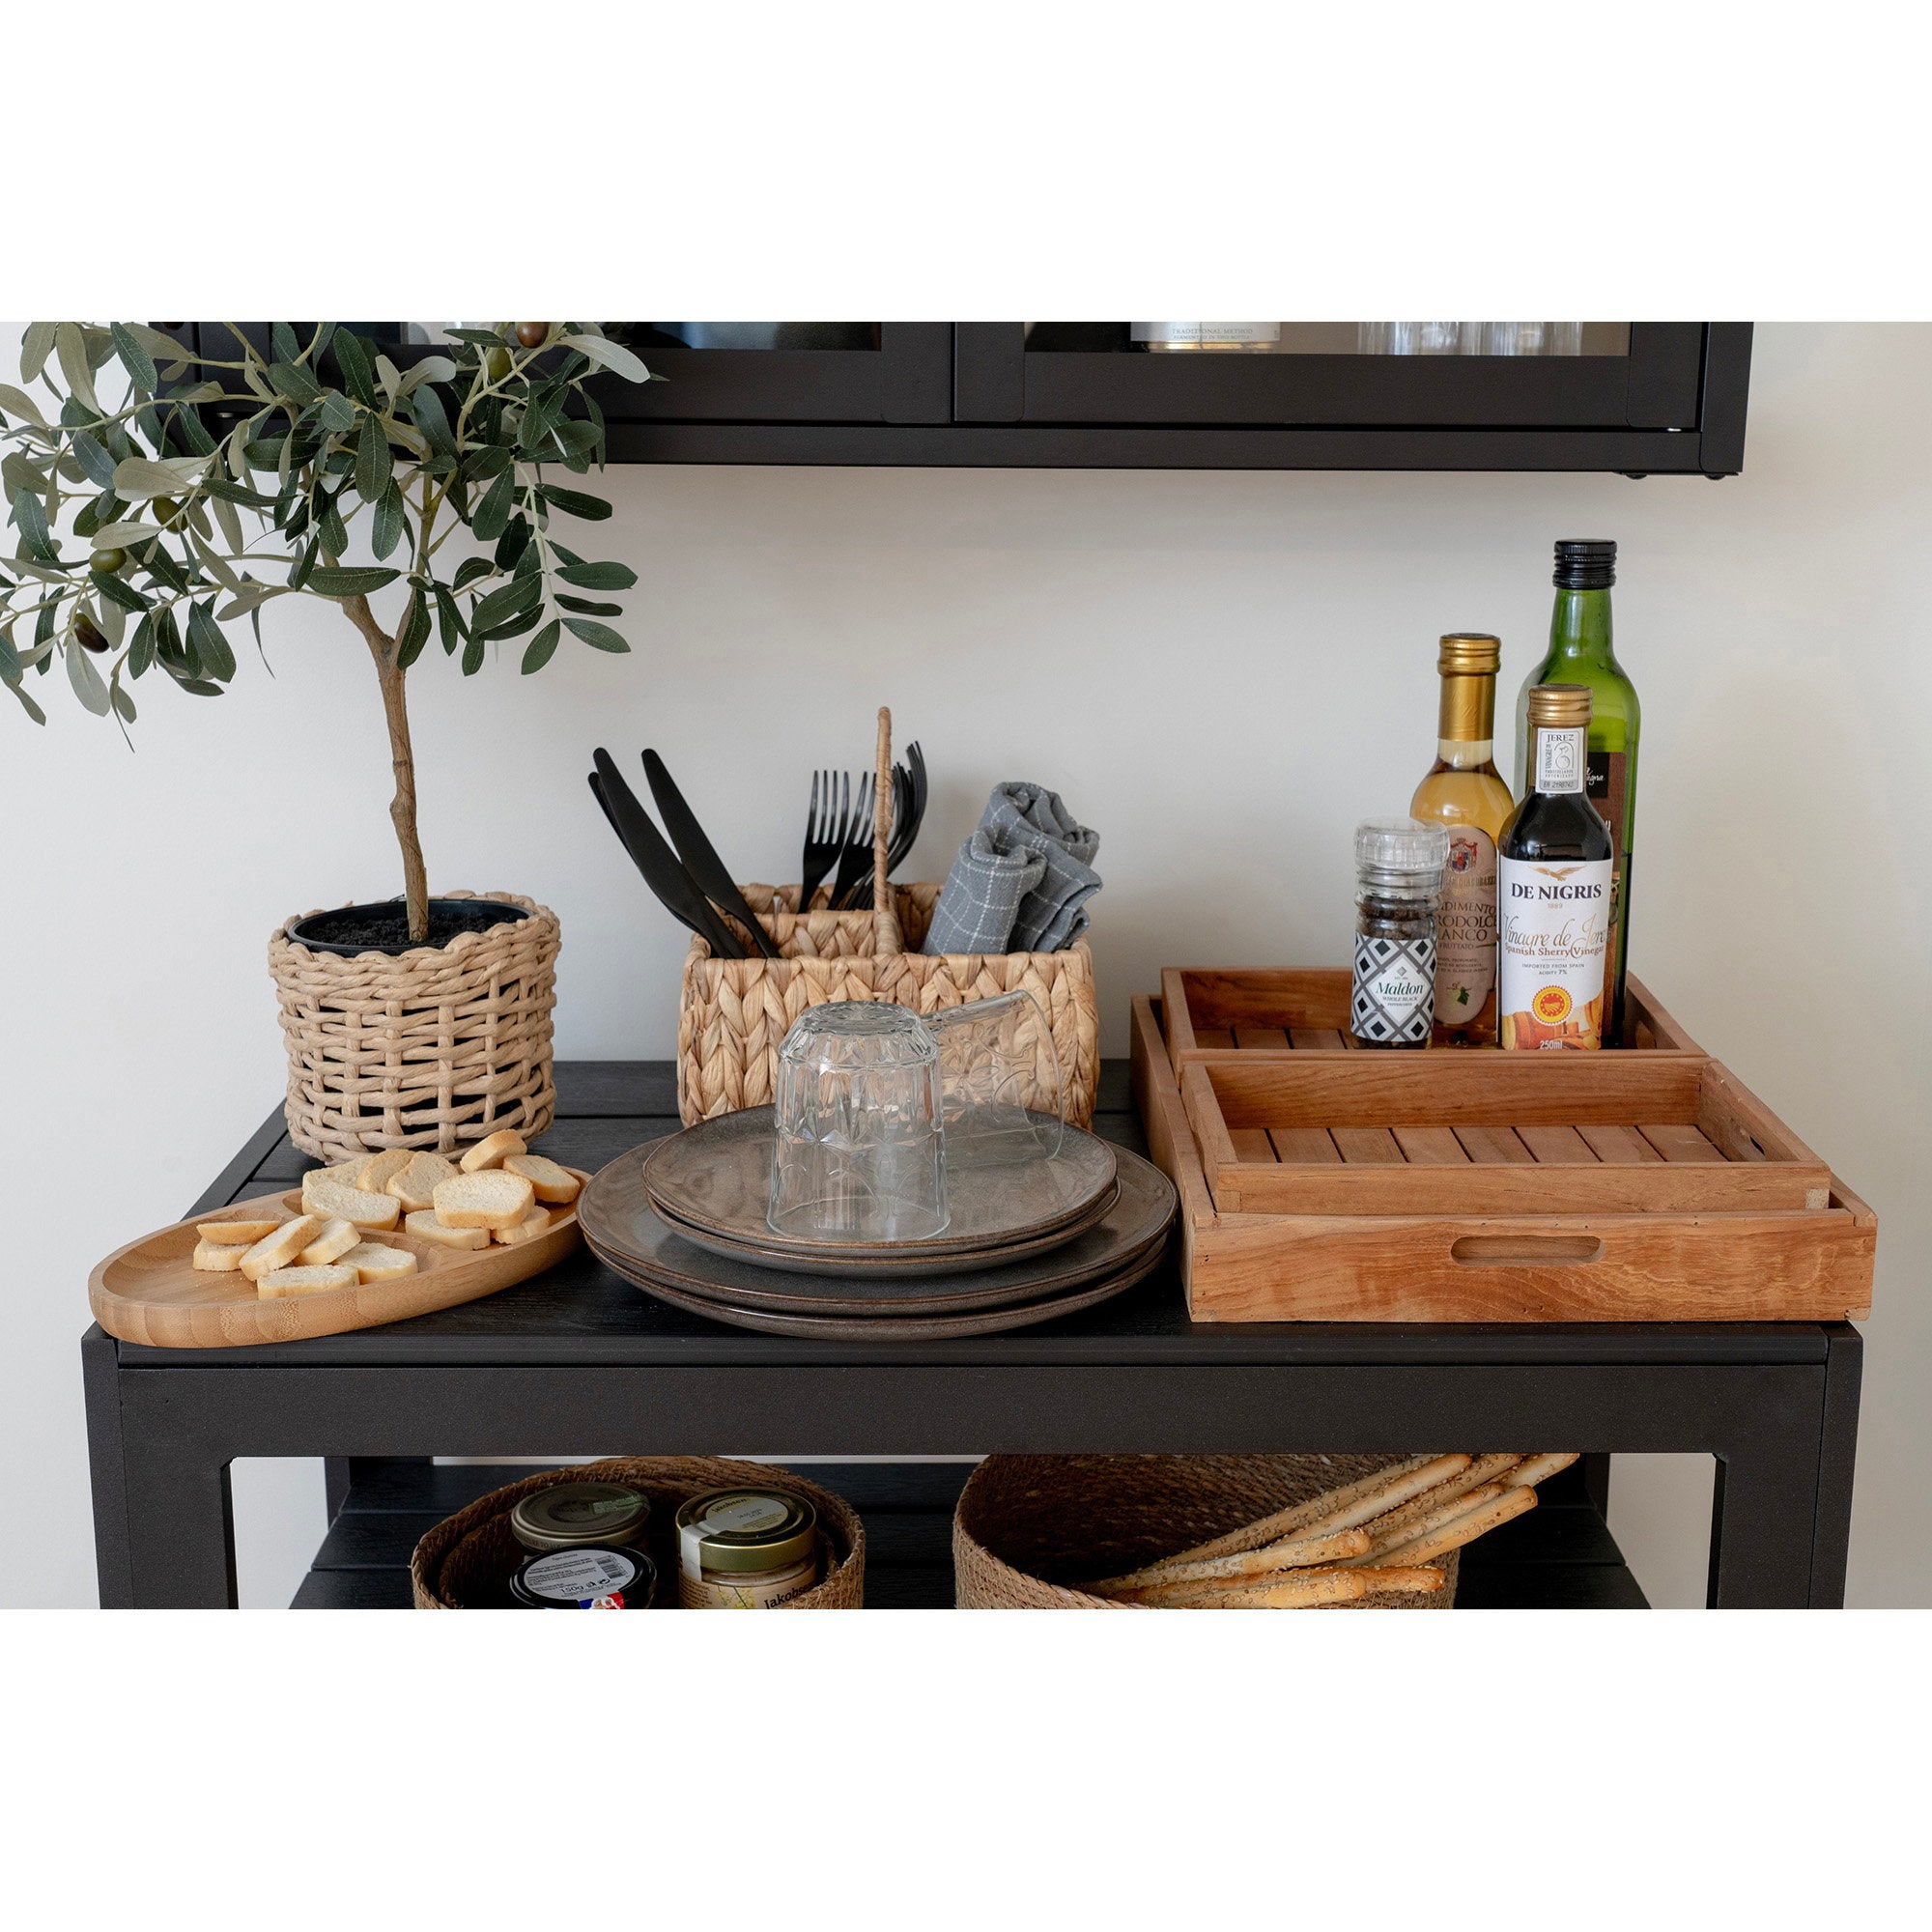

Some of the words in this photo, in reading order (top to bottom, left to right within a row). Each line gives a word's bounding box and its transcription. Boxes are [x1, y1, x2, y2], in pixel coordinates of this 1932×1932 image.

[1547, 734, 1575, 743] JEREZ
[1512, 883, 1534, 899] DE
[1538, 884, 1602, 899] NIGRIS
[1503, 913, 1549, 948] Vinagre
[1552, 919, 1575, 947] de
[1505, 943, 1535, 955] Spanish
[1538, 948, 1571, 958] Sherry
[1377, 982, 1423, 995] Maldon
[1540, 1039, 1563, 1050] 250ml
